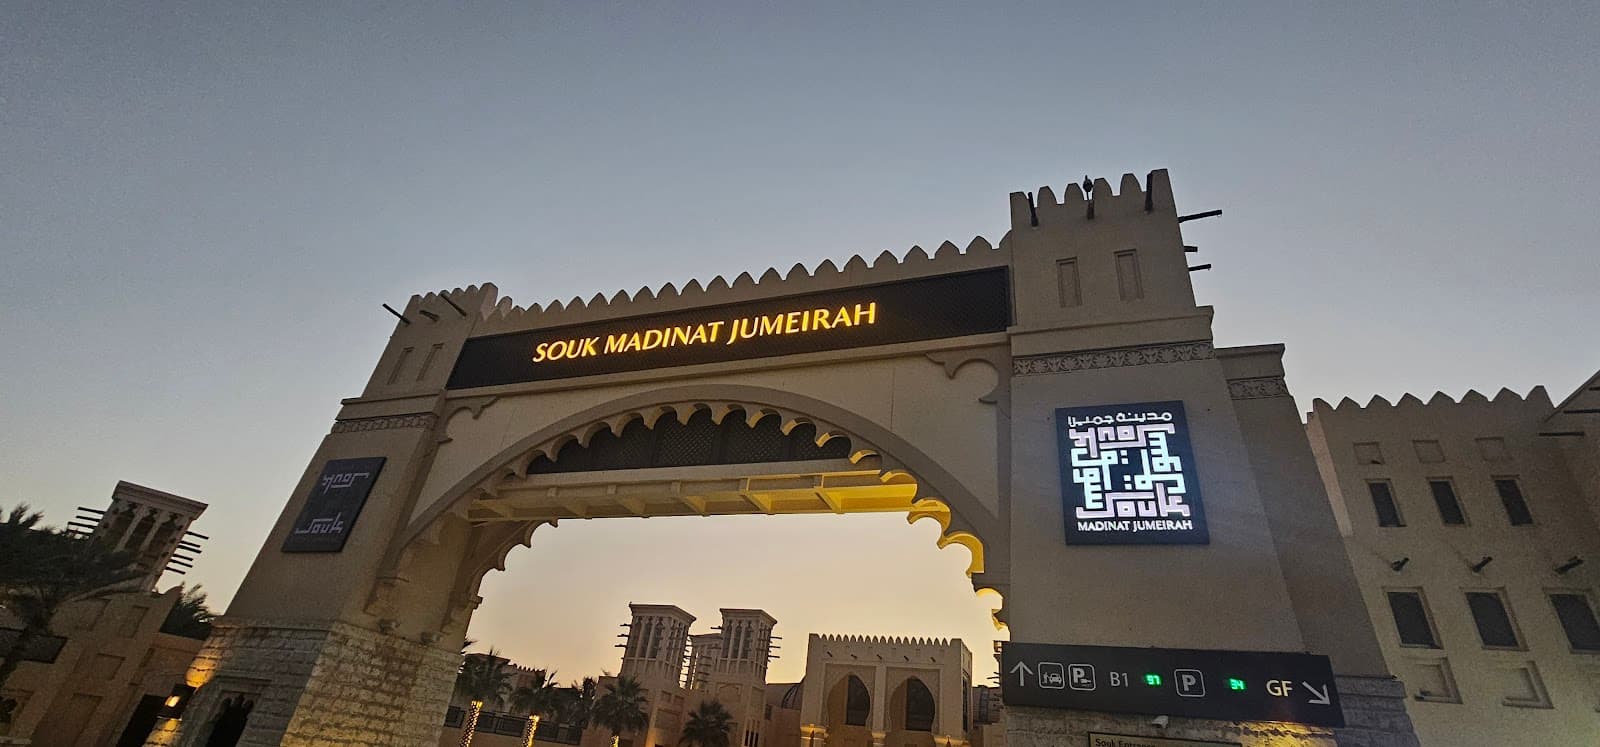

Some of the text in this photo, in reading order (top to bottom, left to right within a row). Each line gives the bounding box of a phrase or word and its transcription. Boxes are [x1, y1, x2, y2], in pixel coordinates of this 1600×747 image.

[532, 302, 876, 362] SOUK MADINAT JUMEIRAH
[1078, 520, 1193, 532] MADINAT JUMEIRAH
[1110, 672, 1128, 687] B1
[1182, 674, 1196, 691] P
[1266, 680, 1292, 696] GF
